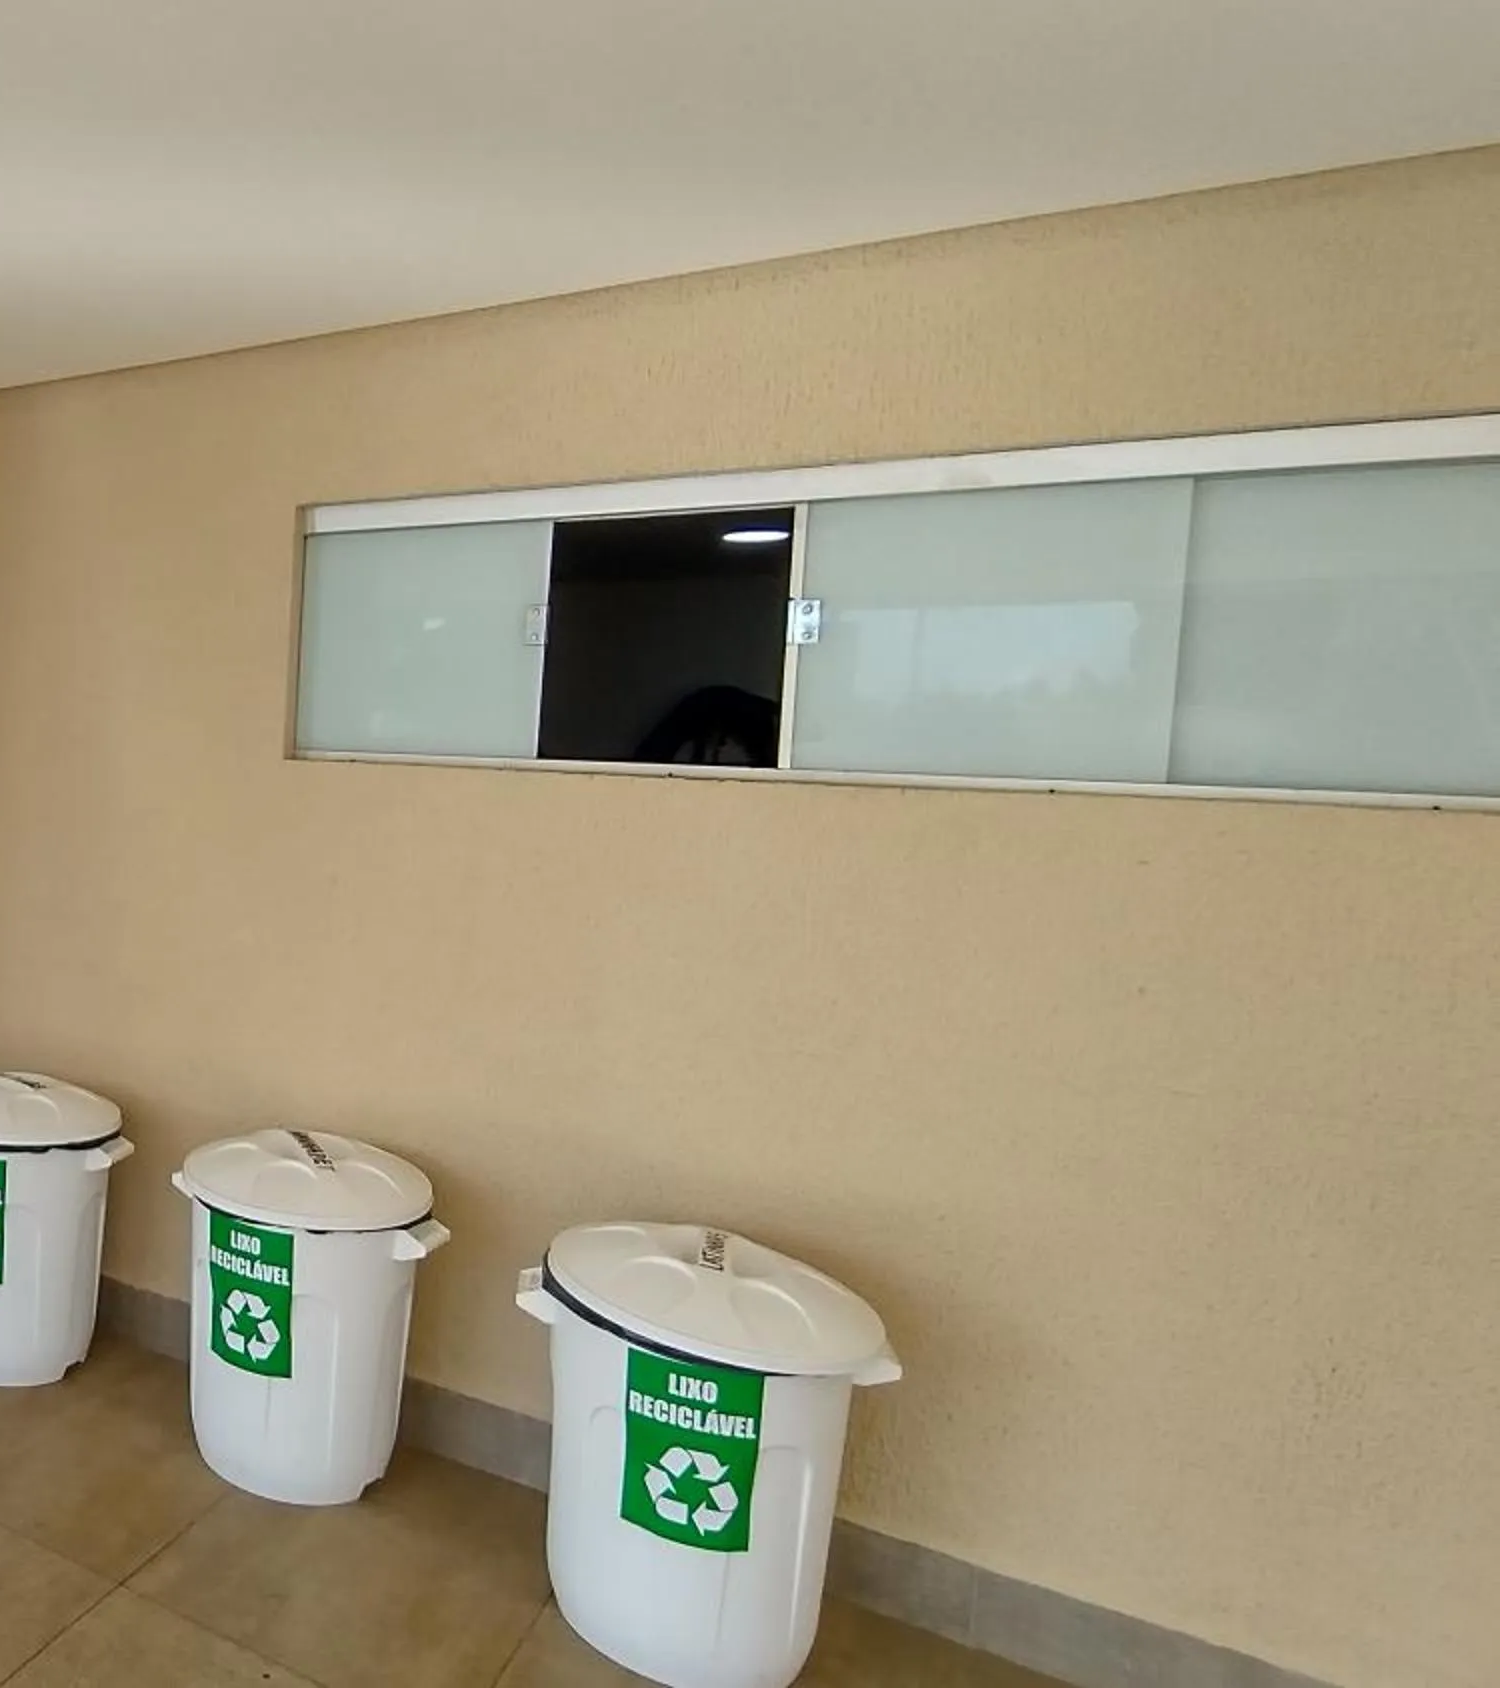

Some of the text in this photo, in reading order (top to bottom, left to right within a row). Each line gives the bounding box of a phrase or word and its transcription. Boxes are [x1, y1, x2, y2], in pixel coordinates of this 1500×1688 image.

[230, 1229, 261, 1255] LIXO
[211, 1244, 290, 1286] RECICLÁVEL
[667, 1372, 718, 1404] LIXO
[628, 1389, 756, 1439] RECICLÁVEL
